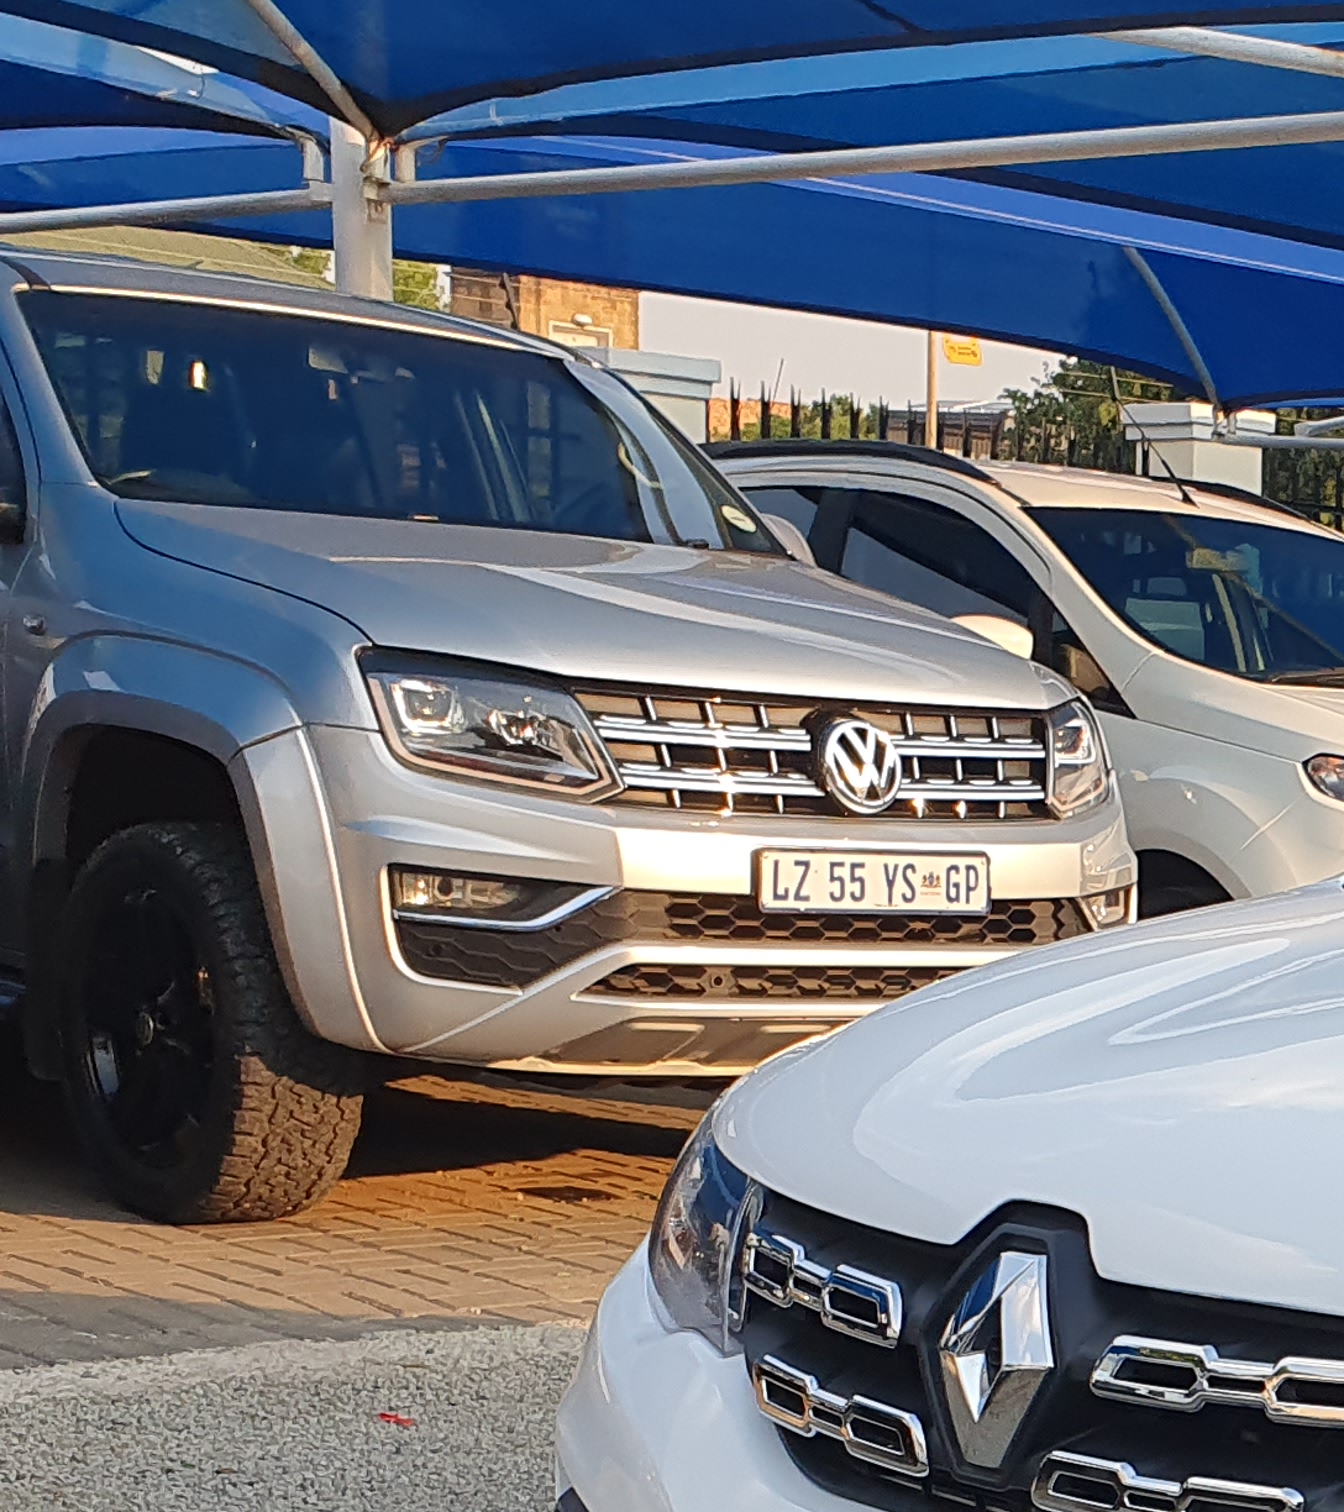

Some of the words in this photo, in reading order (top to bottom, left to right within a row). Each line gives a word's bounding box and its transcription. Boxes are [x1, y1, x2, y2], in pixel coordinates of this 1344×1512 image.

[772, 859, 811, 902] LZ
[829, 861, 866, 903] 55
[883, 862, 917, 904] YS
[945, 863, 979, 905] GP
